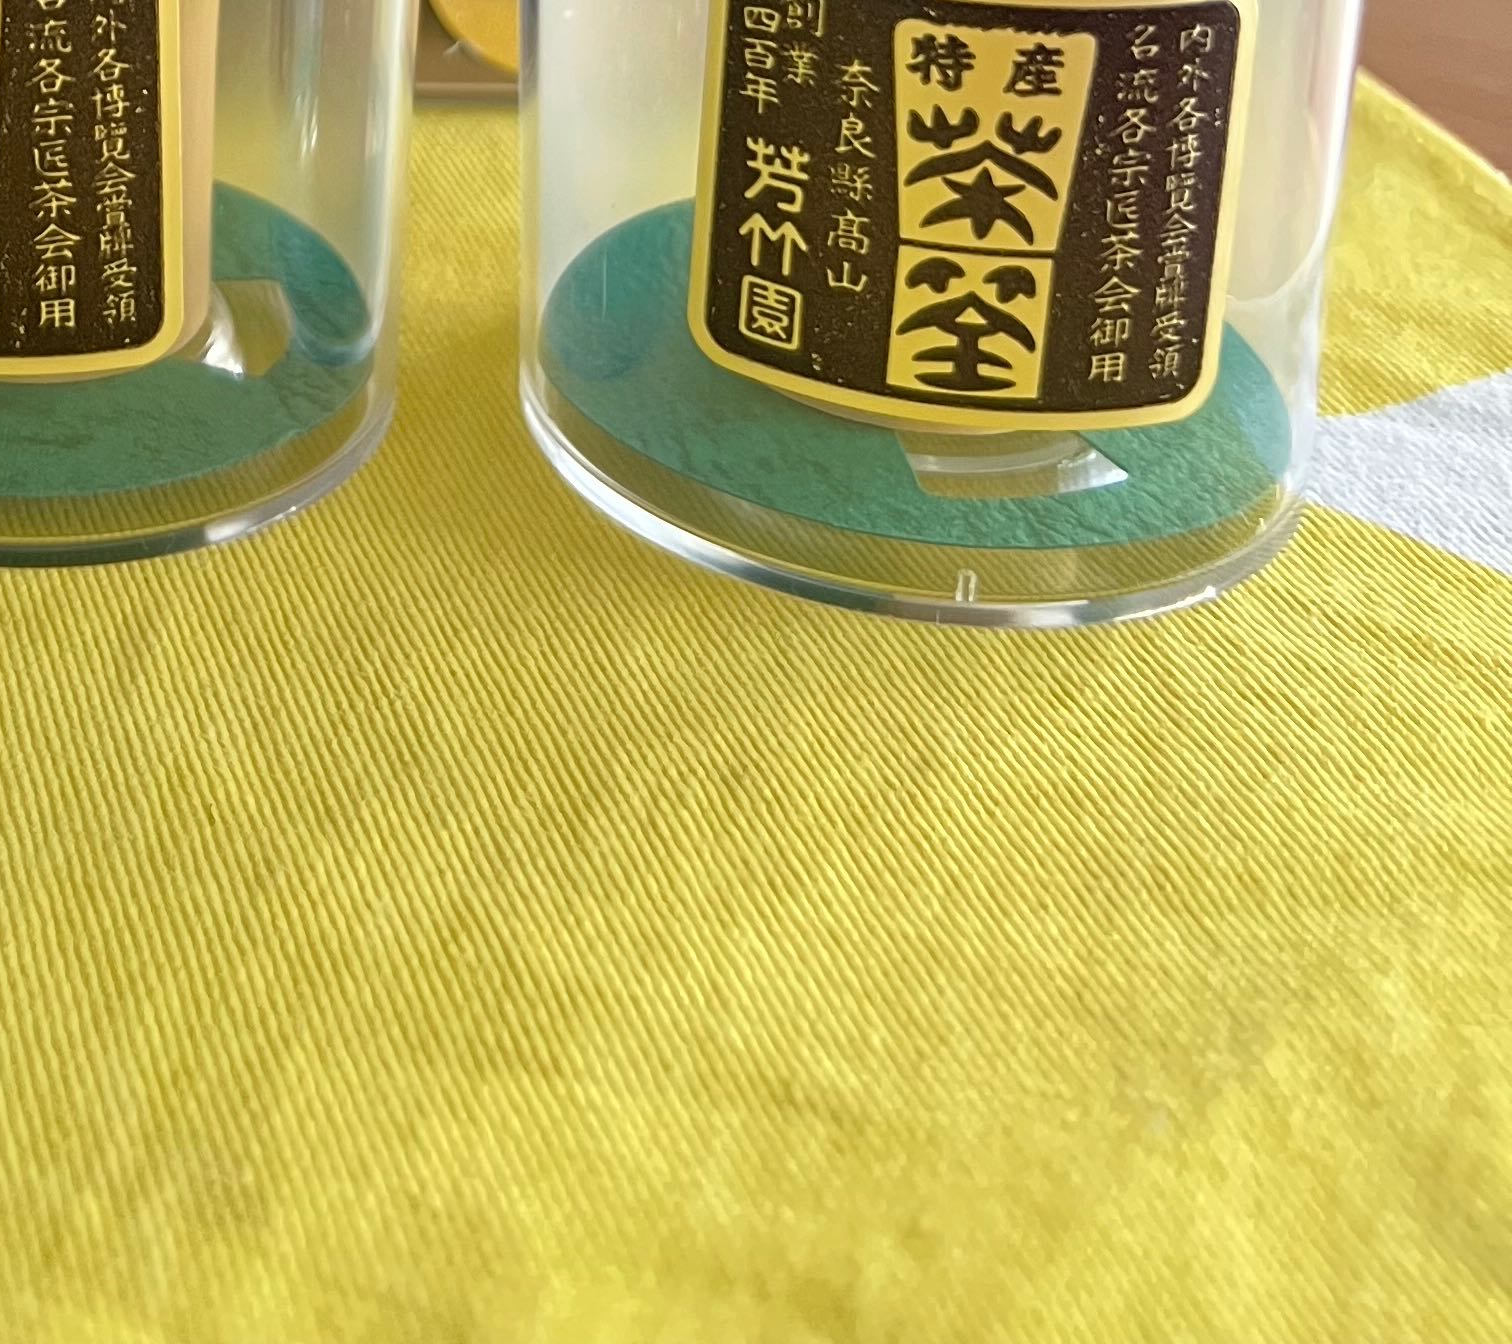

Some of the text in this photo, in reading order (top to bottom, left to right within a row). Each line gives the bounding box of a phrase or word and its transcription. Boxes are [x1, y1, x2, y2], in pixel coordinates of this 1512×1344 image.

[738, 3, 781, 115] 四百年
[904, 32, 1066, 98] 特産
